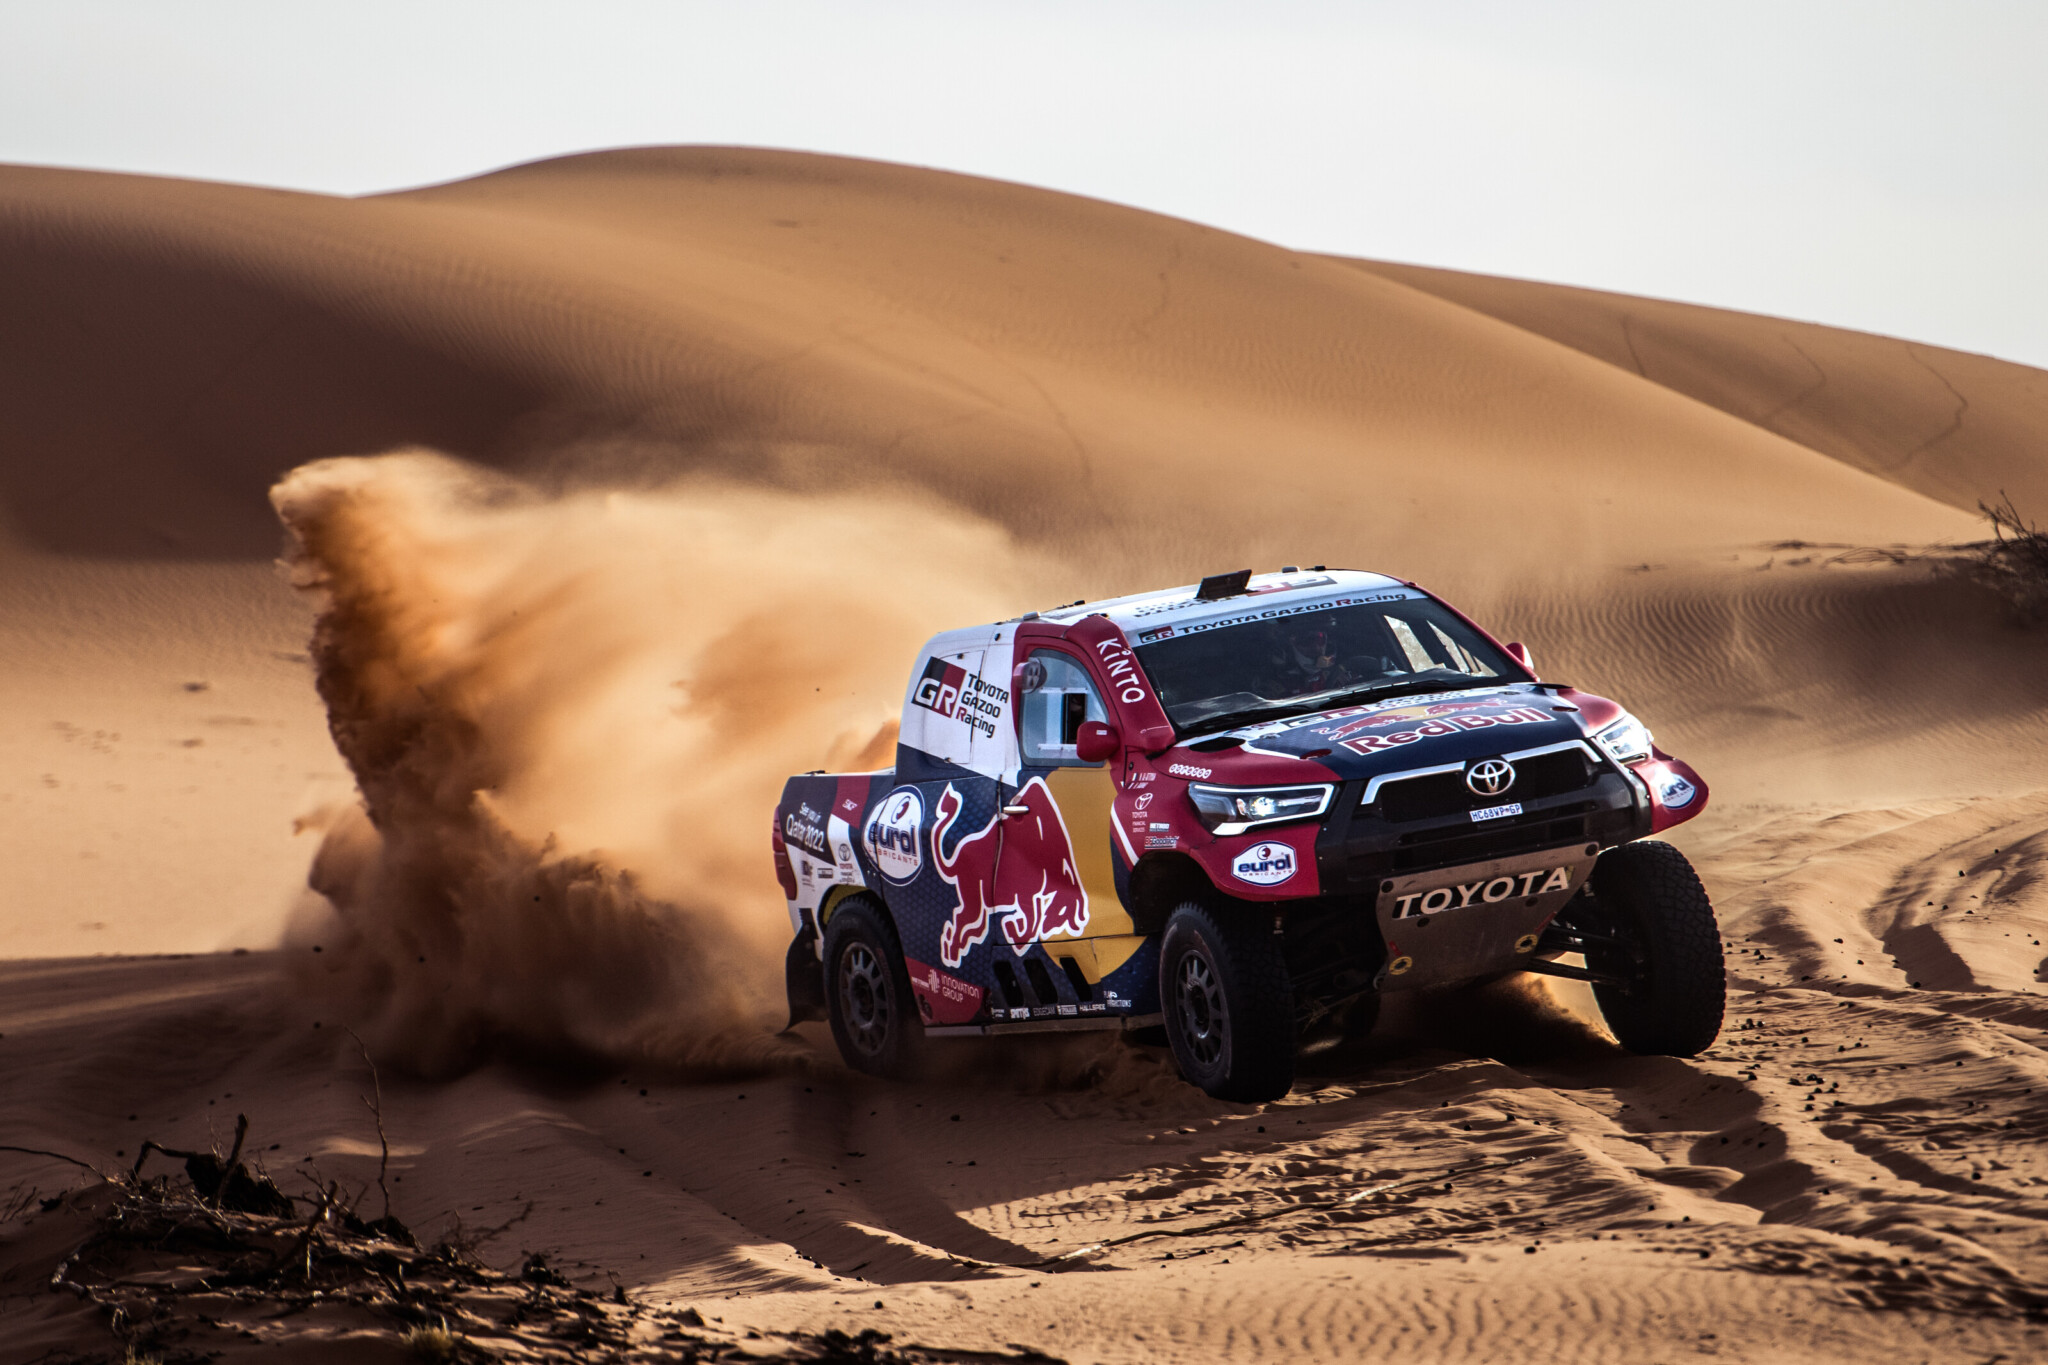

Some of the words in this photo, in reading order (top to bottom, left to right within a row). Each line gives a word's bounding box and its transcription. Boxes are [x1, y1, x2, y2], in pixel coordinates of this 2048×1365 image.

[1142, 630, 1174, 643] GR
[1178, 613, 1258, 634] TOYOTA
[1261, 602, 1334, 619] GAZOO
[1335, 593, 1407, 608] Racing
[914, 677, 957, 716] GR
[968, 673, 1009, 703] TOYOTA
[961, 691, 1001, 719] GAZOO
[956, 706, 995, 738] Racing
[804, 824, 825, 853] 2022
[1238, 853, 1292, 873] eurol
[1396, 866, 1570, 919] TOYOTA
[942, 986, 963, 1003] GROUP
